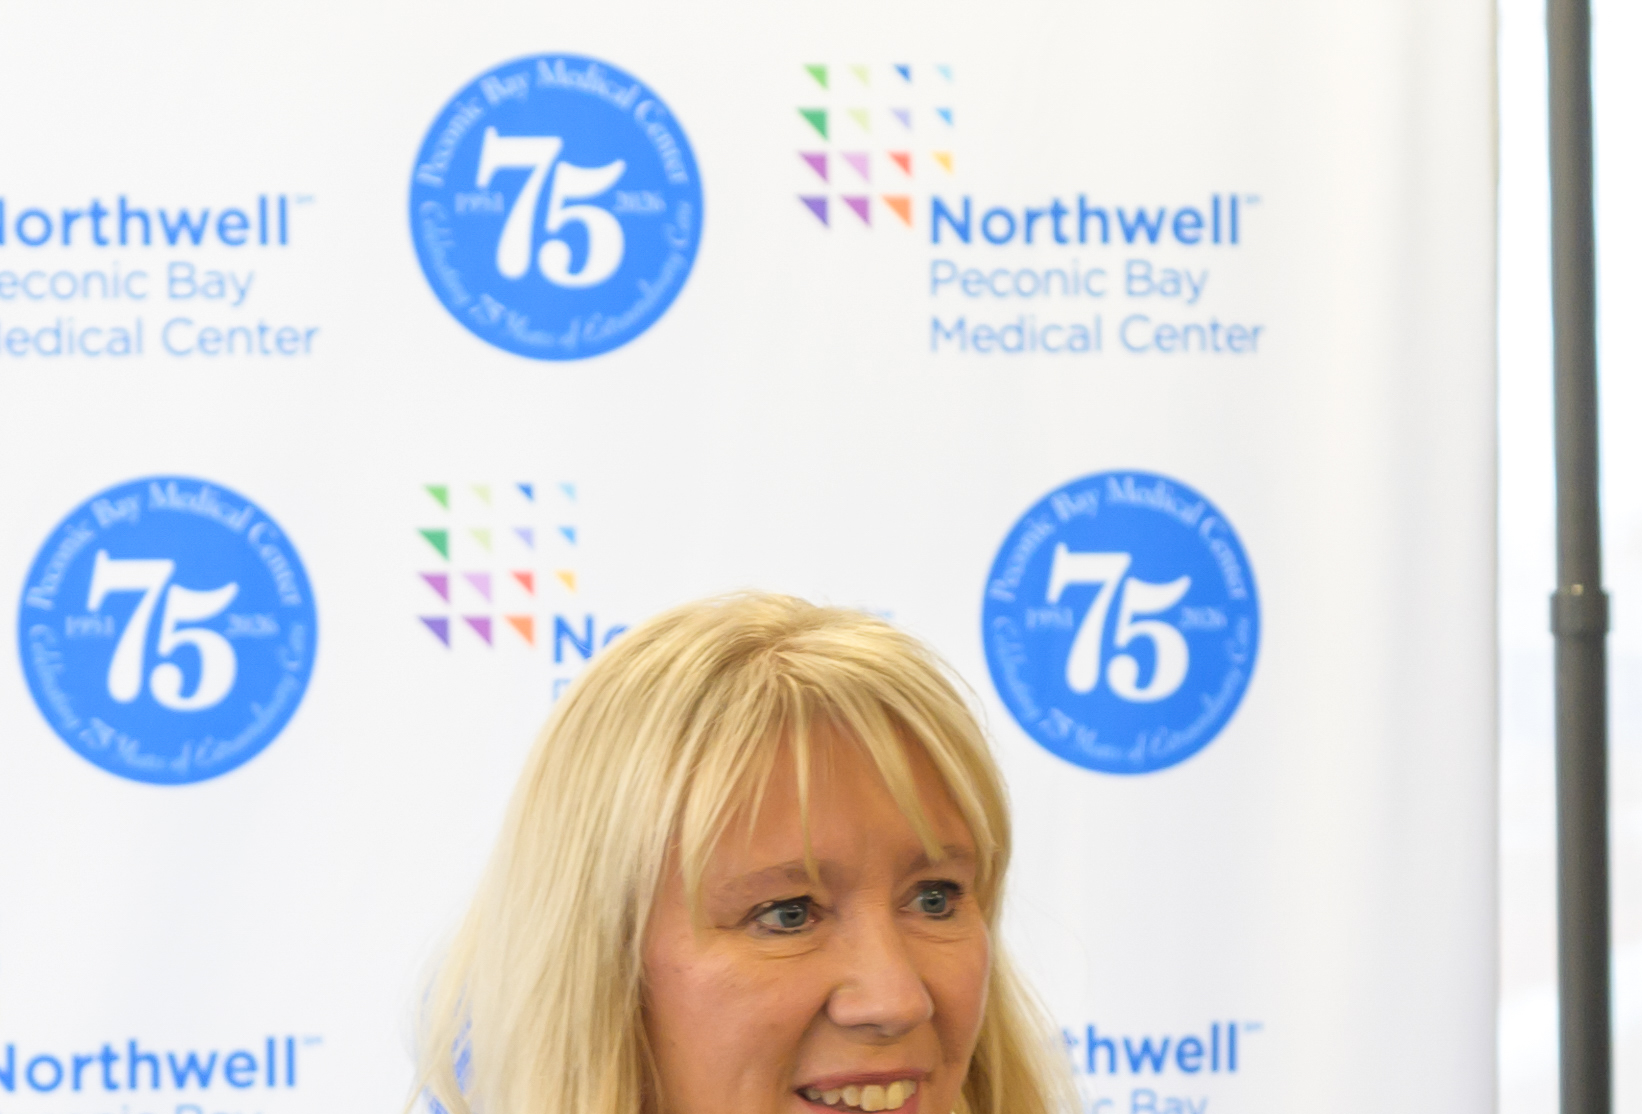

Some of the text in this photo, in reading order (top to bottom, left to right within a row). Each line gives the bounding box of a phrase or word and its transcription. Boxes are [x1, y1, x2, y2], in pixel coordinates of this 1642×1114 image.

[480, 74, 528, 105] Bay
[537, 60, 640, 108] Medical
[0, 196, 288, 247] orthwell
[476, 126, 626, 288] 75
[931, 196, 1238, 245] Northwell
[0, 261, 253, 307] econic Bay
[930, 259, 1207, 305] Peconic Bay
[4, 318, 318, 357] edical Center
[931, 314, 1262, 354] Medical Center
[91, 496, 139, 527] Bay
[149, 482, 252, 531] Medical
[1051, 491, 1098, 521] Bay
[1107, 478, 1203, 524] Medical
[86, 550, 239, 711] 75
[1046, 543, 1191, 702] 75
[1064, 1021, 1237, 1074] hwell
